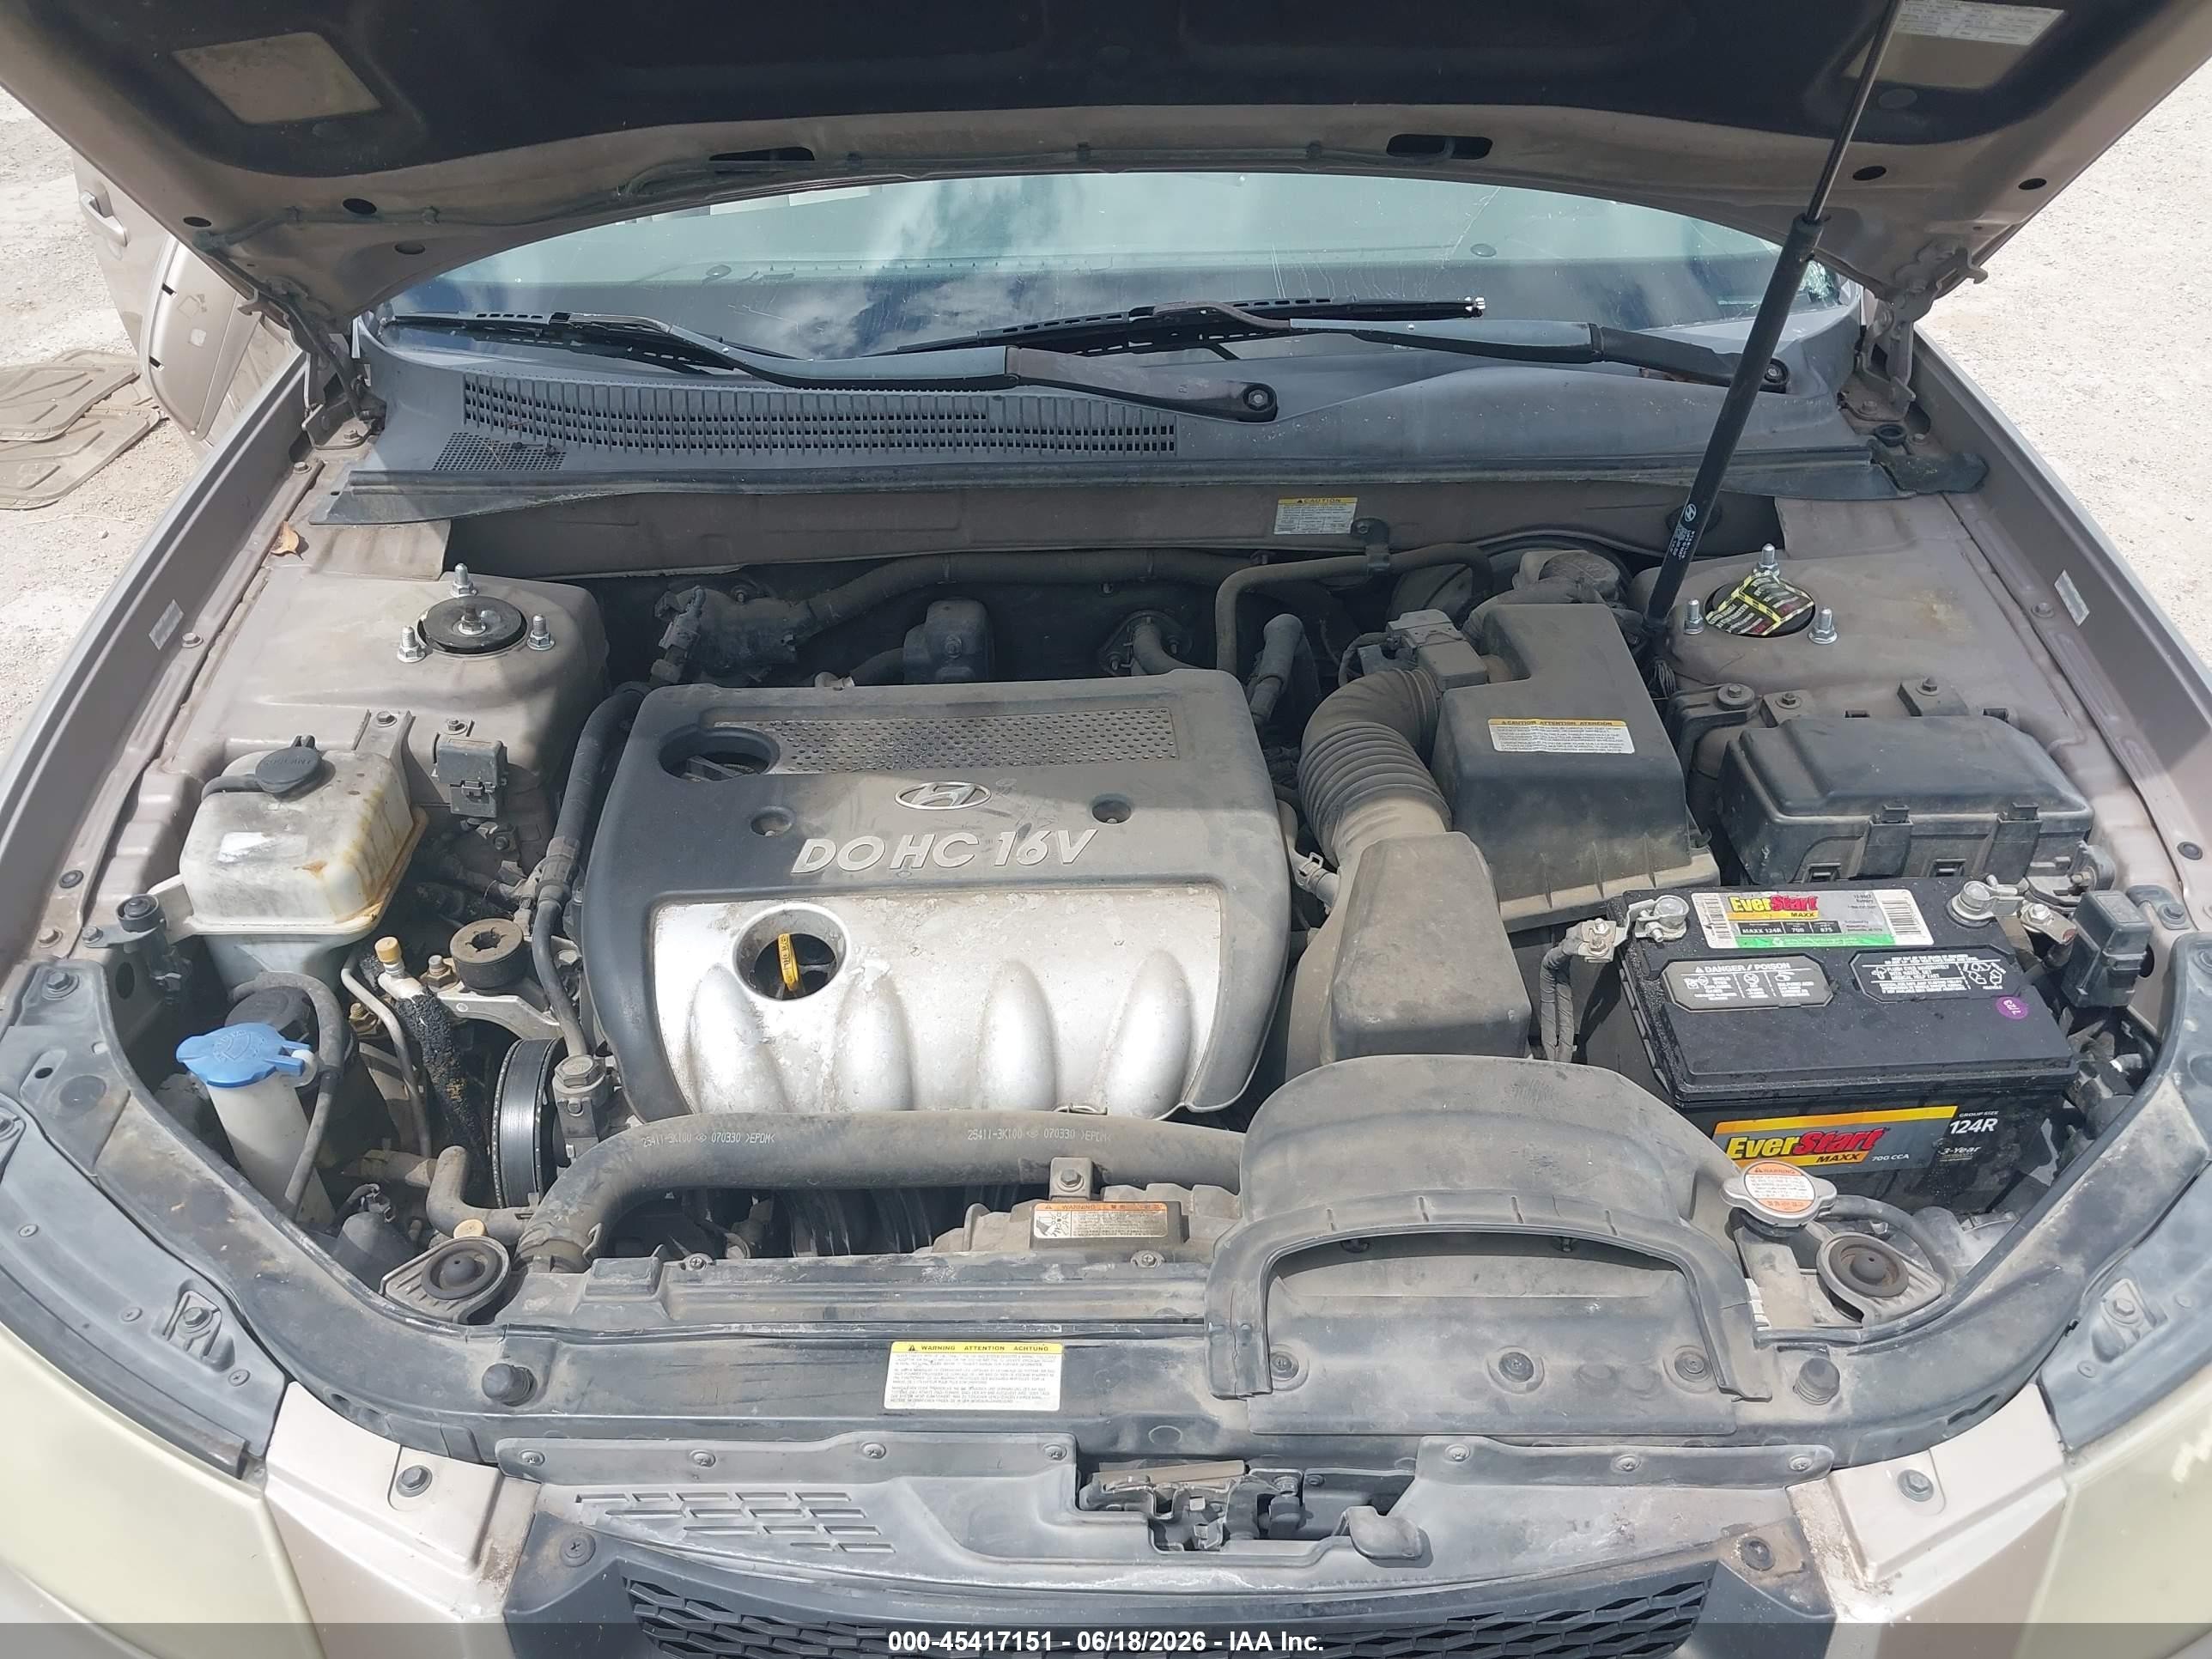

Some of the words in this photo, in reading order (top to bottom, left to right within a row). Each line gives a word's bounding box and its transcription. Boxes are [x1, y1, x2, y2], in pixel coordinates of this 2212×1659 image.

[993, 829, 1098, 867] 16V
[1729, 895, 1818, 913] EverStart
[1705, 964, 1747, 973] DANGER
[1753, 962, 1791, 970] POISON
[1043, 1127, 1075, 1139] 070330
[1949, 1118, 1999, 1134] 124R
[711, 1133, 741, 1144] 070330
[1726, 1127, 1884, 1159] EverStart
[1815, 1153, 1861, 1163] MAXX
